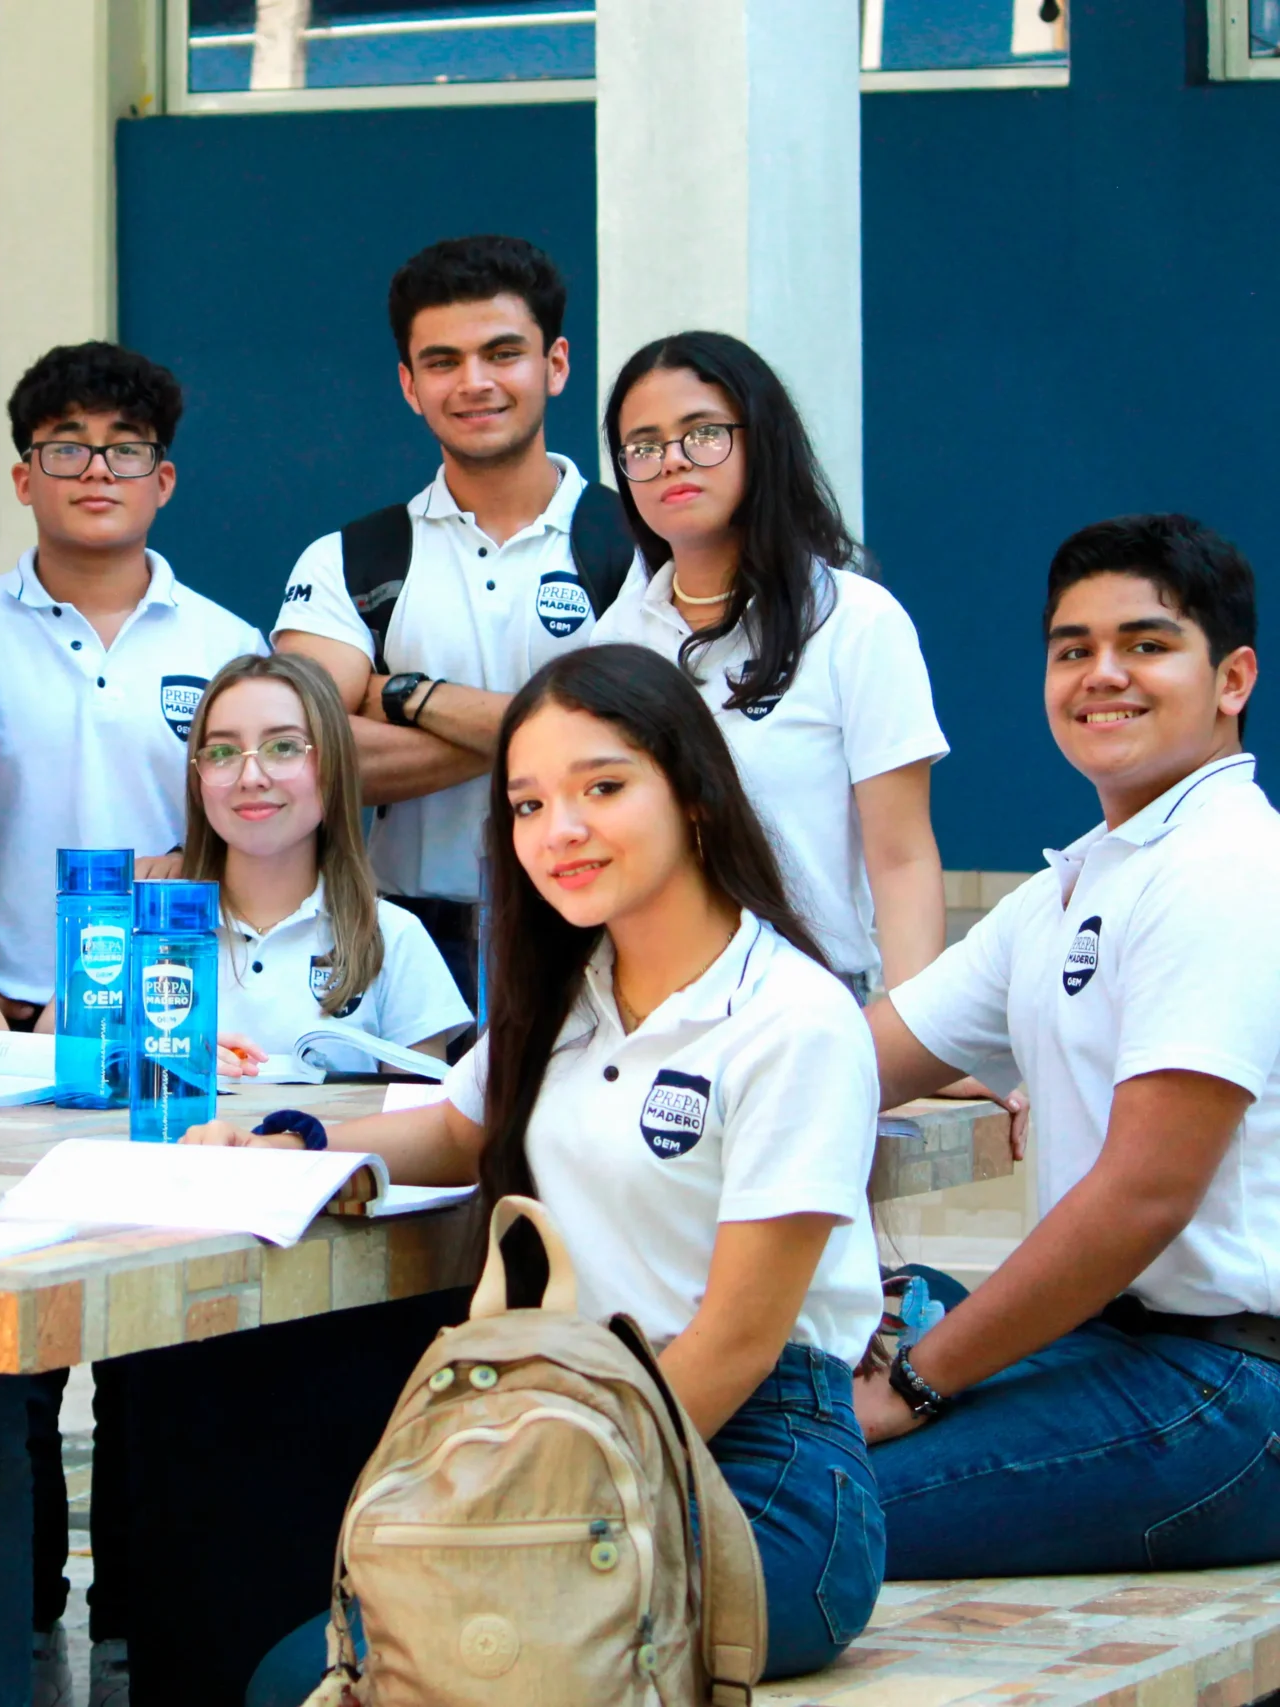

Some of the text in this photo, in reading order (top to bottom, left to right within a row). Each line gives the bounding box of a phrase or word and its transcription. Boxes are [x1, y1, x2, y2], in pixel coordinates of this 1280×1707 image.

[284, 584, 312, 604] EM
[542, 586, 587, 603] PREPA
[540, 600, 586, 614] MADERO
[549, 621, 571, 632] GEM
[165, 689, 200, 704] PREP
[165, 703, 195, 715] MADE
[746, 706, 768, 715] GEM
[1071, 936, 1096, 951] PREPA
[1066, 953, 1095, 965] MADERO
[146, 981, 189, 995] PREPA
[1067, 977, 1082, 987] GEM
[82, 989, 123, 1005] GEM
[146, 996, 189, 1006] MADERO
[145, 1036, 190, 1053] GEM
[651, 1088, 701, 1115] PREPA
[646, 1106, 701, 1129] MADERO
[653, 1136, 681, 1152] GEM
